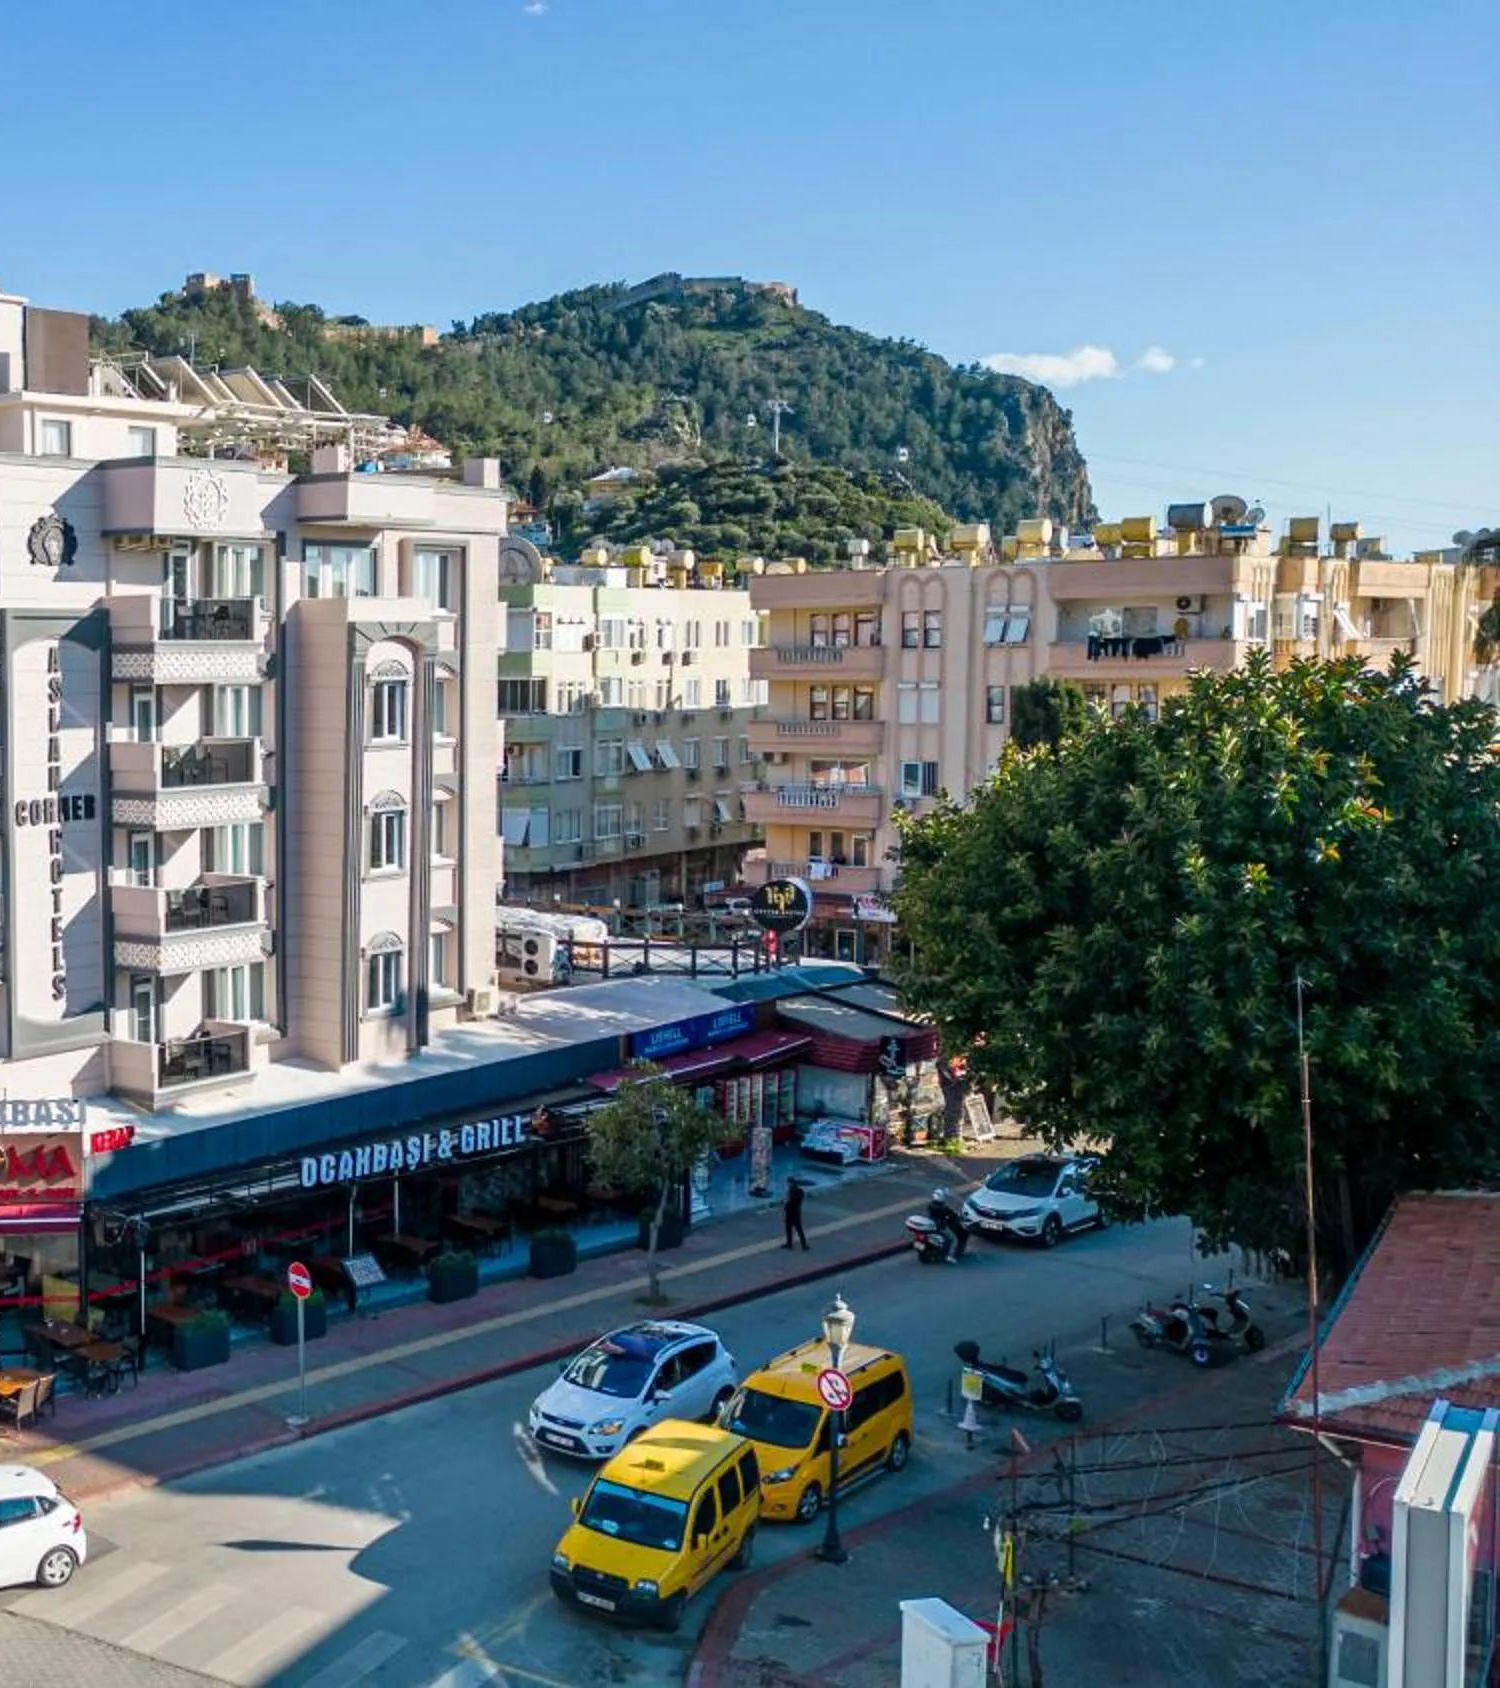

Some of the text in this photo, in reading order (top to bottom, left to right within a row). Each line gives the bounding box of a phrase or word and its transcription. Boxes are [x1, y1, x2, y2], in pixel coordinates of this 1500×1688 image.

[15, 795, 96, 827] CORNER
[49, 829, 66, 1001] HOTELS
[301, 1114, 526, 1188] OCAKBAŞI & GRILL
